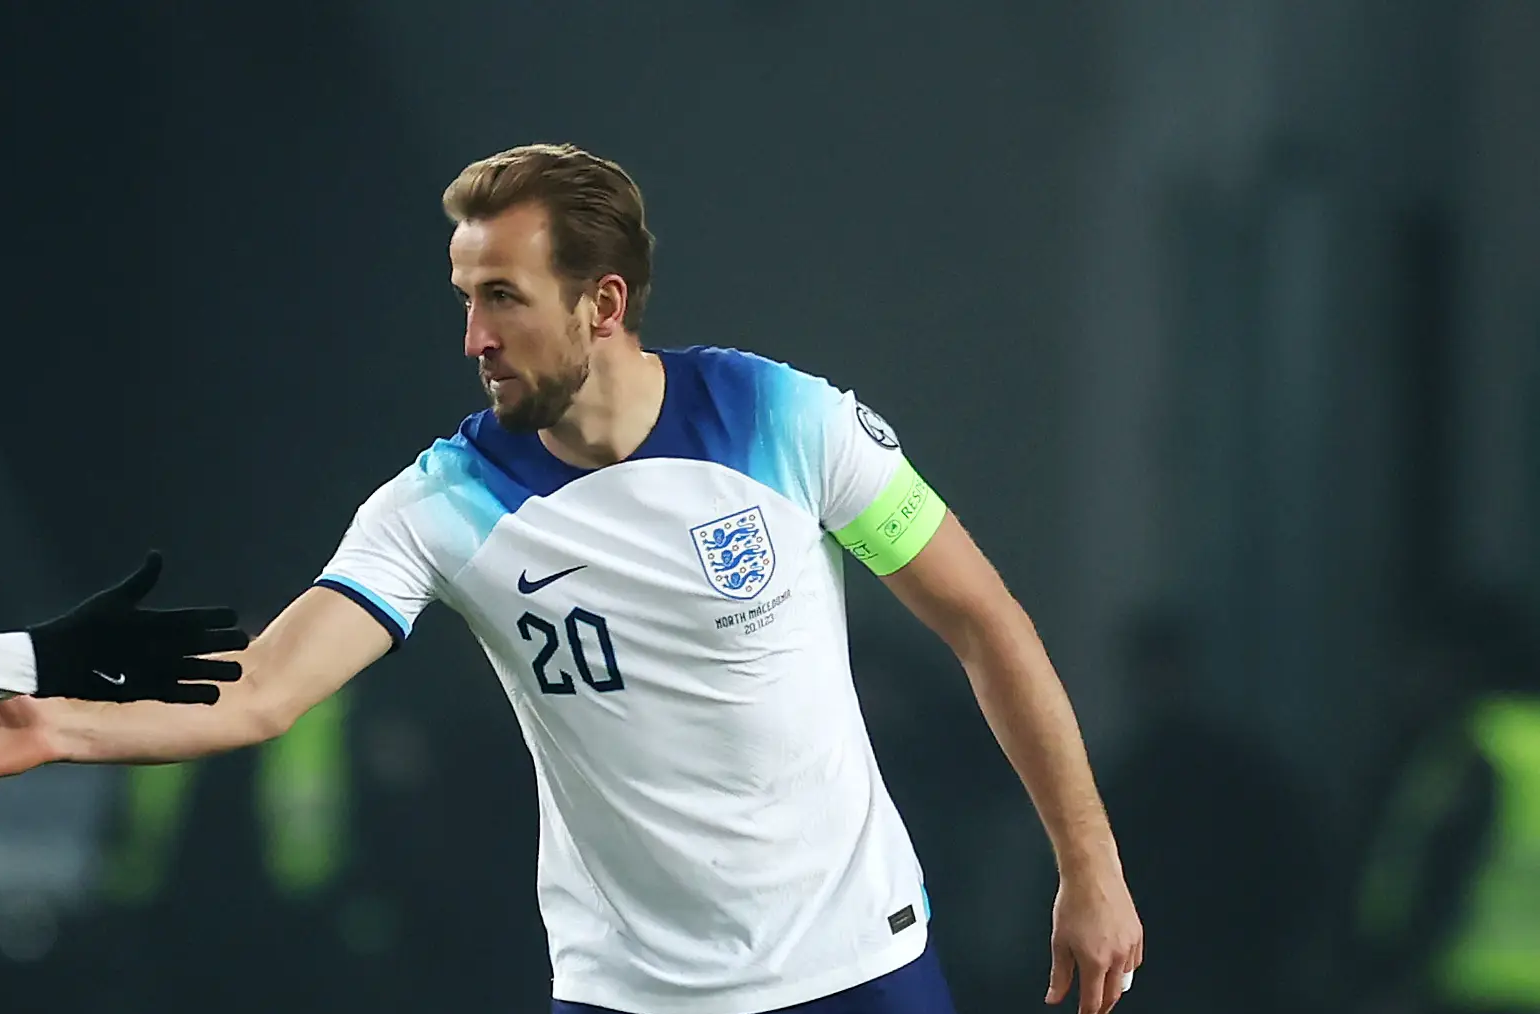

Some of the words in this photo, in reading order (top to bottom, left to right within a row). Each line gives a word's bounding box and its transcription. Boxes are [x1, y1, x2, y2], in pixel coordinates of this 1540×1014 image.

[715, 612, 747, 630] NORTH
[748, 589, 792, 619] MACEDONIA
[517, 607, 625, 695] 20
